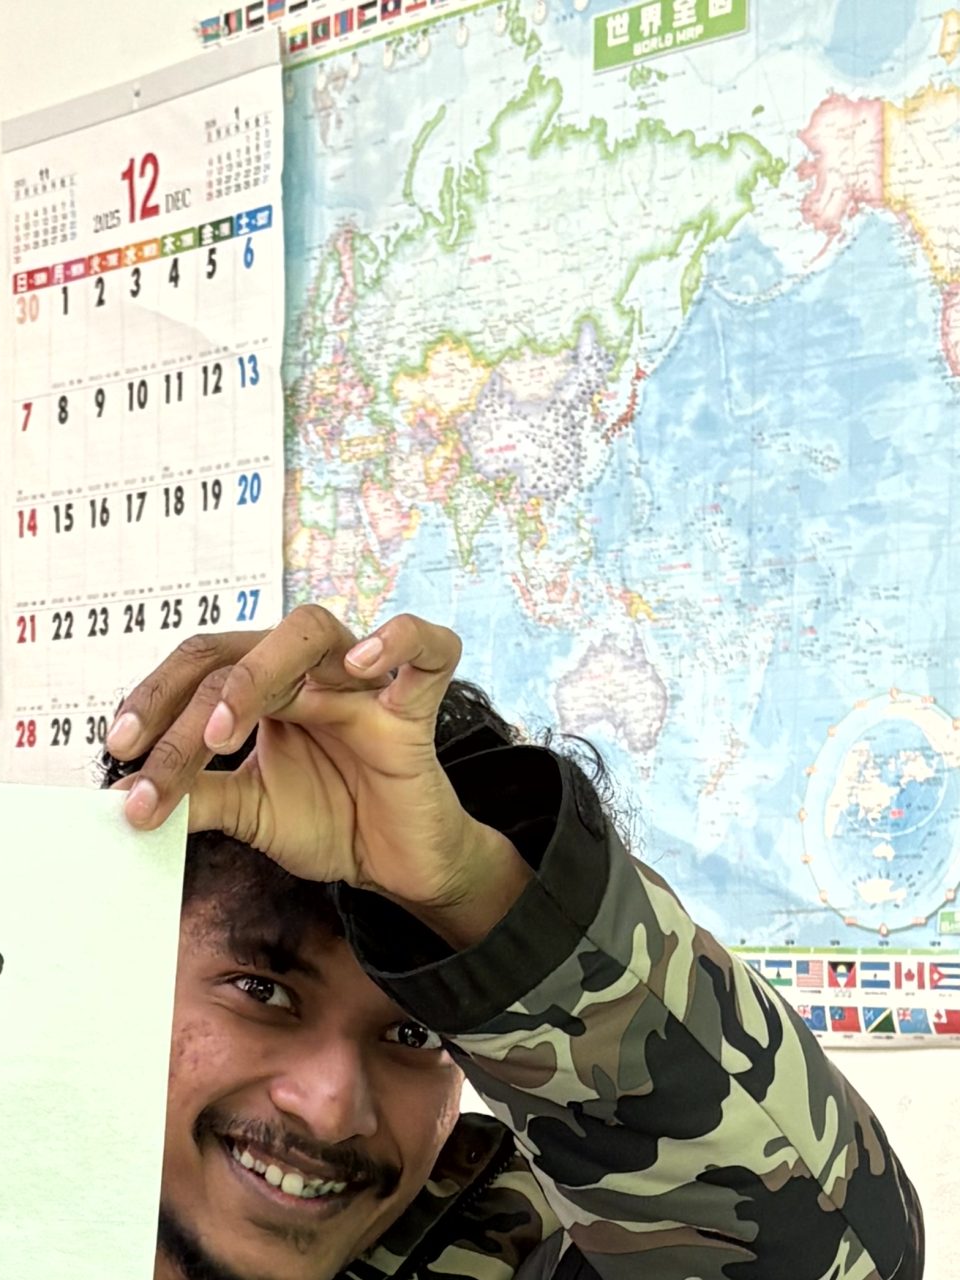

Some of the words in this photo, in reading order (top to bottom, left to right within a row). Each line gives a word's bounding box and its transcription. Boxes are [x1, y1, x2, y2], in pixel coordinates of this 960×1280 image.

[121, 153, 160, 223] 12
[165, 187, 192, 213] DEC
[16, 294, 39, 324] 30
[62, 286, 68, 315] 1
[95, 278, 105, 307] 2
[130, 268, 141, 298] 3
[169, 258, 179, 287] 4
[206, 248, 217, 279] 5
[244, 238, 254, 269] 6
[22, 402, 33, 432] 7
[58, 396, 68, 424] 8
[95, 388, 105, 417] 9
[128, 380, 148, 411] 10
[164, 371, 183, 404] 11
[202, 362, 223, 396] 12
[238, 354, 259, 388] 13
[17, 508, 37, 538] 14
[53, 503, 74, 534] 15
[89, 497, 110, 528] 16
[126, 491, 147, 523] 17
[163, 486, 184, 517] 18
[201, 479, 222, 512] 19
[237, 473, 261, 505] 20
[17, 614, 36, 643] 21
[52, 611, 74, 641] 22
[87, 607, 109, 637] 23
[123, 603, 145, 634] 24
[160, 599, 183, 630] 25
[198, 594, 221, 626] 26
[236, 589, 261, 621] 27
[15, 719, 37, 748] 28
[50, 718, 72, 746] 29
[86, 715, 108, 745] 30
